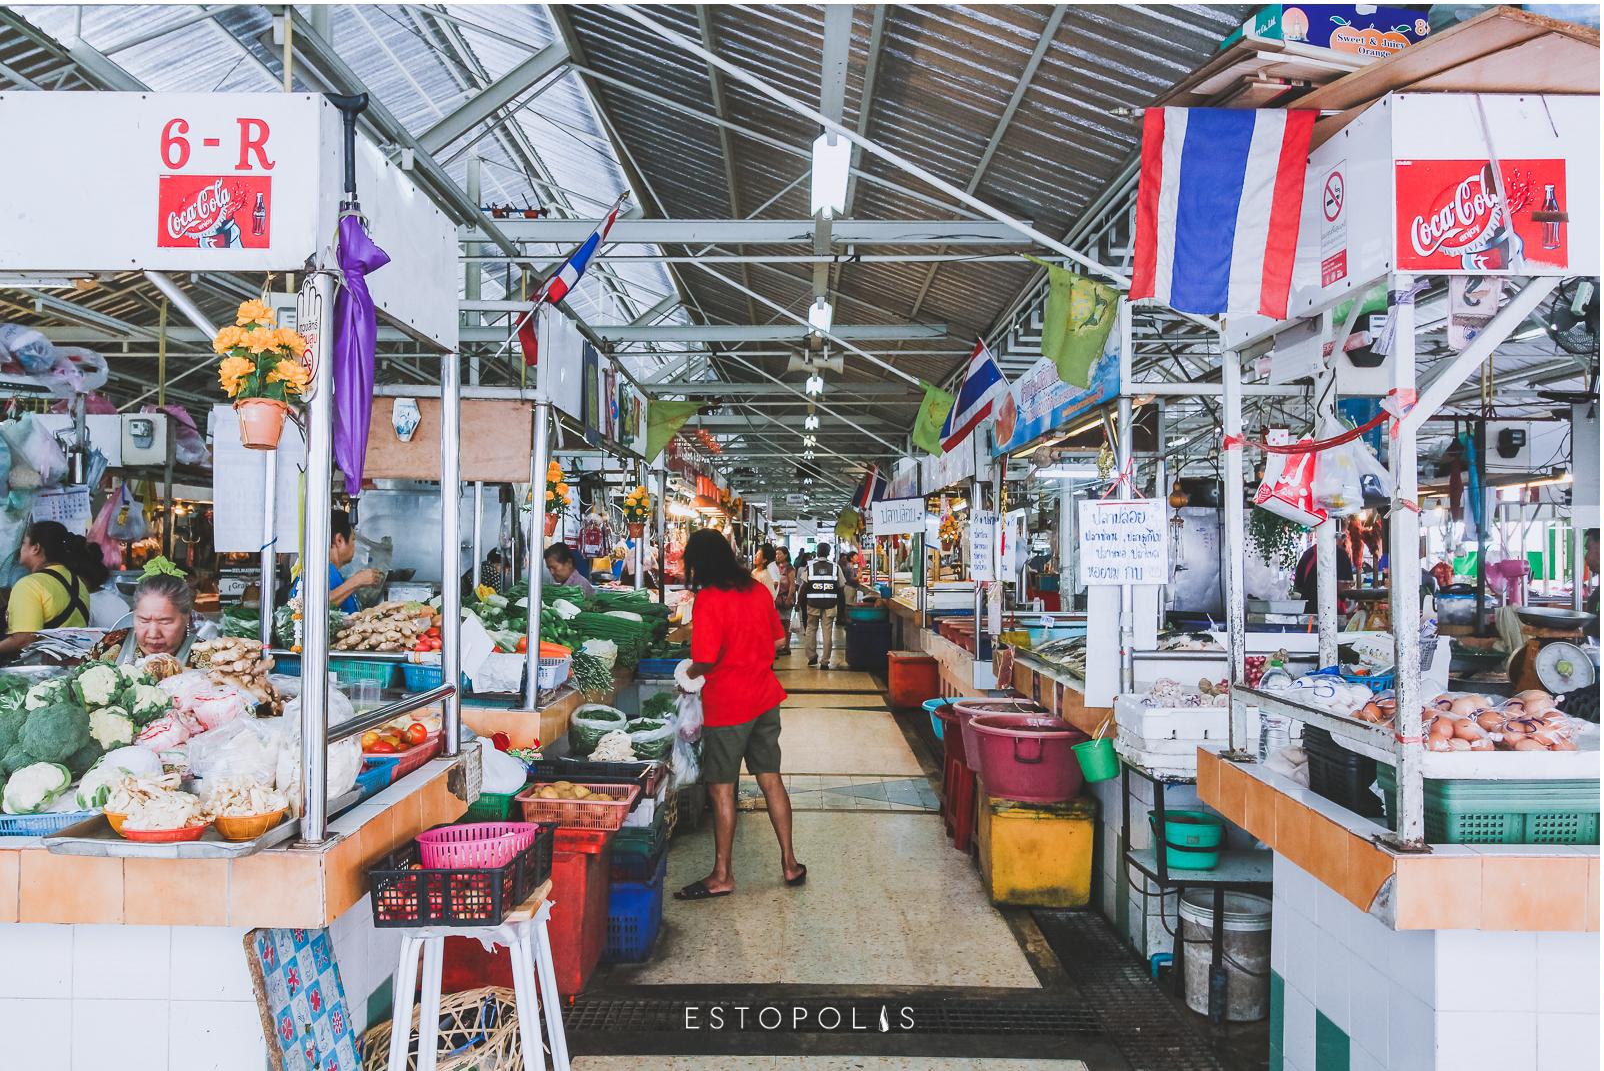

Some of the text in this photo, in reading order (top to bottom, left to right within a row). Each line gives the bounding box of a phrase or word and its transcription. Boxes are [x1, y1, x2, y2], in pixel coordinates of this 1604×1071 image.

[1337, 33, 1365, 46] Sweet
[1369, 38, 1377, 46] &
[161, 118, 191, 170] 6
[234, 118, 276, 171] R
[1458, 224, 1480, 242] enjoy
